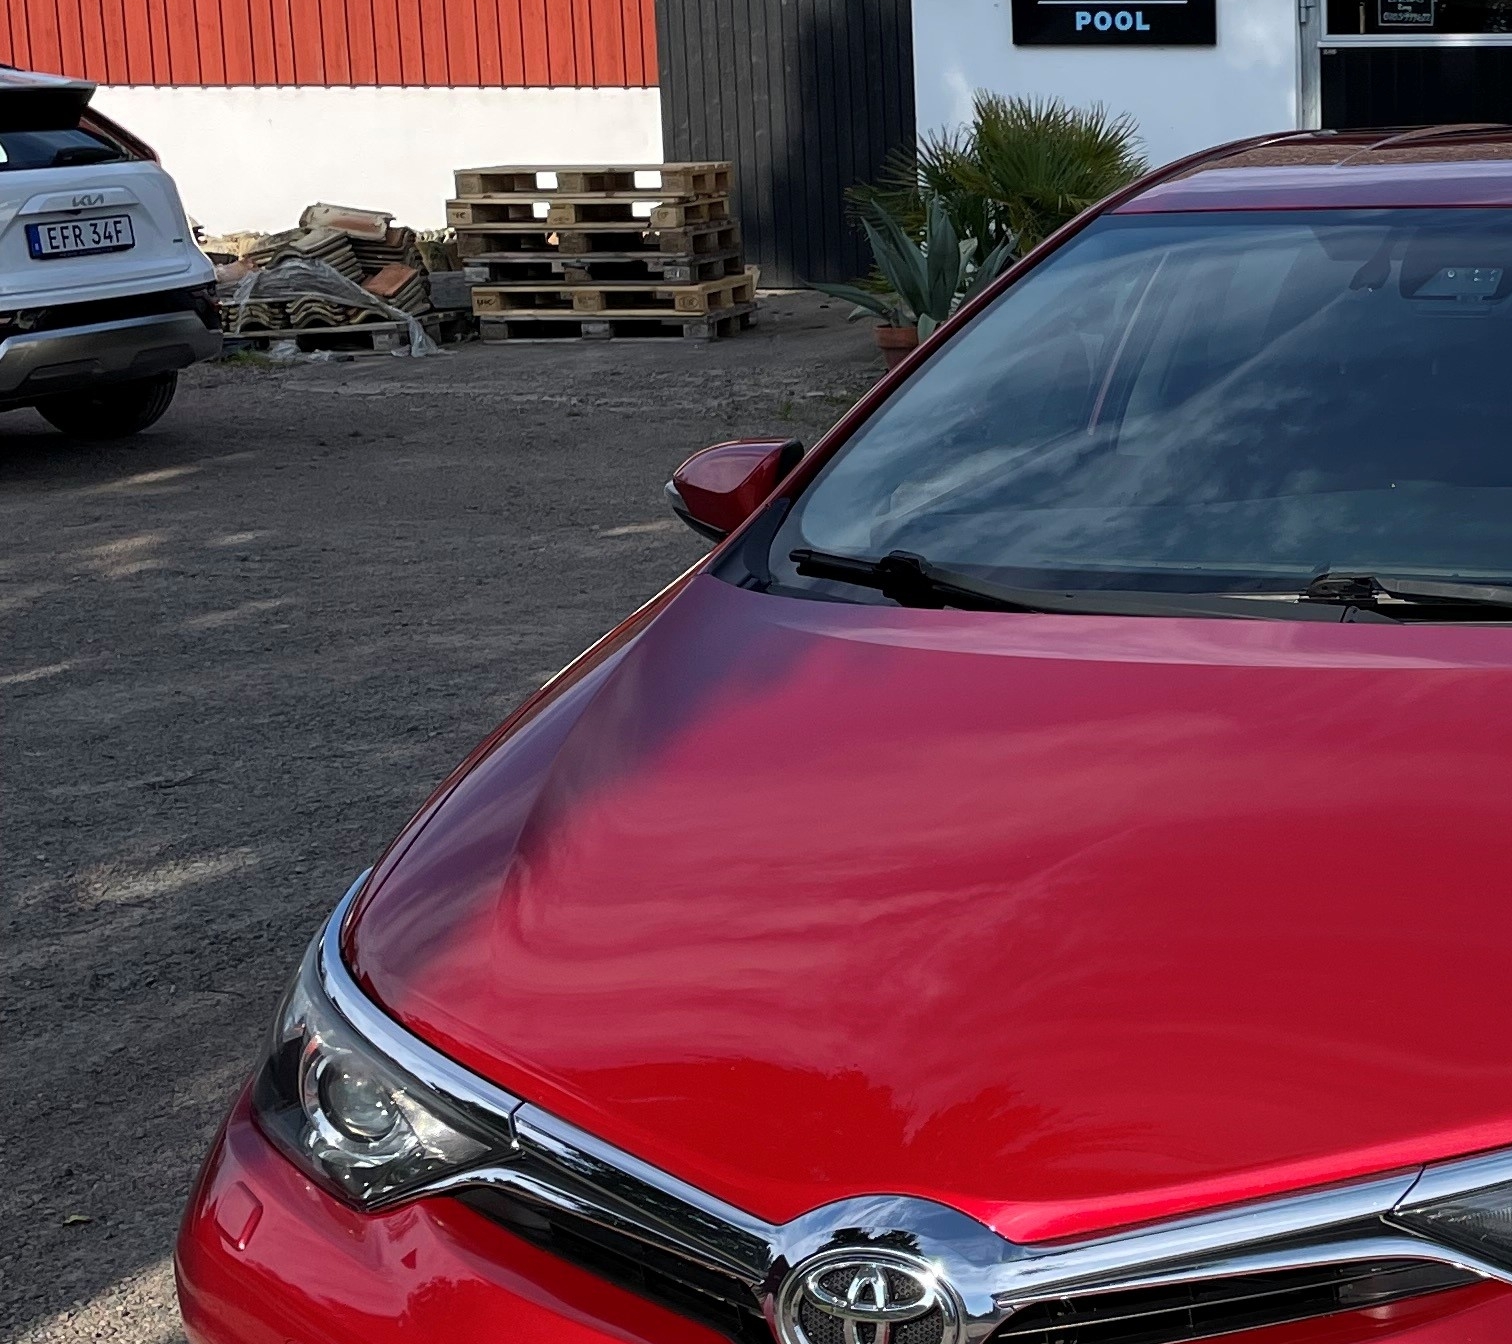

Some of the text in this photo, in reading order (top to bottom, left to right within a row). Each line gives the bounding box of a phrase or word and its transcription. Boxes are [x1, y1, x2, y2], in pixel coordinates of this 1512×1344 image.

[1075, 11, 1150, 31] POOL
[47, 220, 122, 249] EFR 34F
